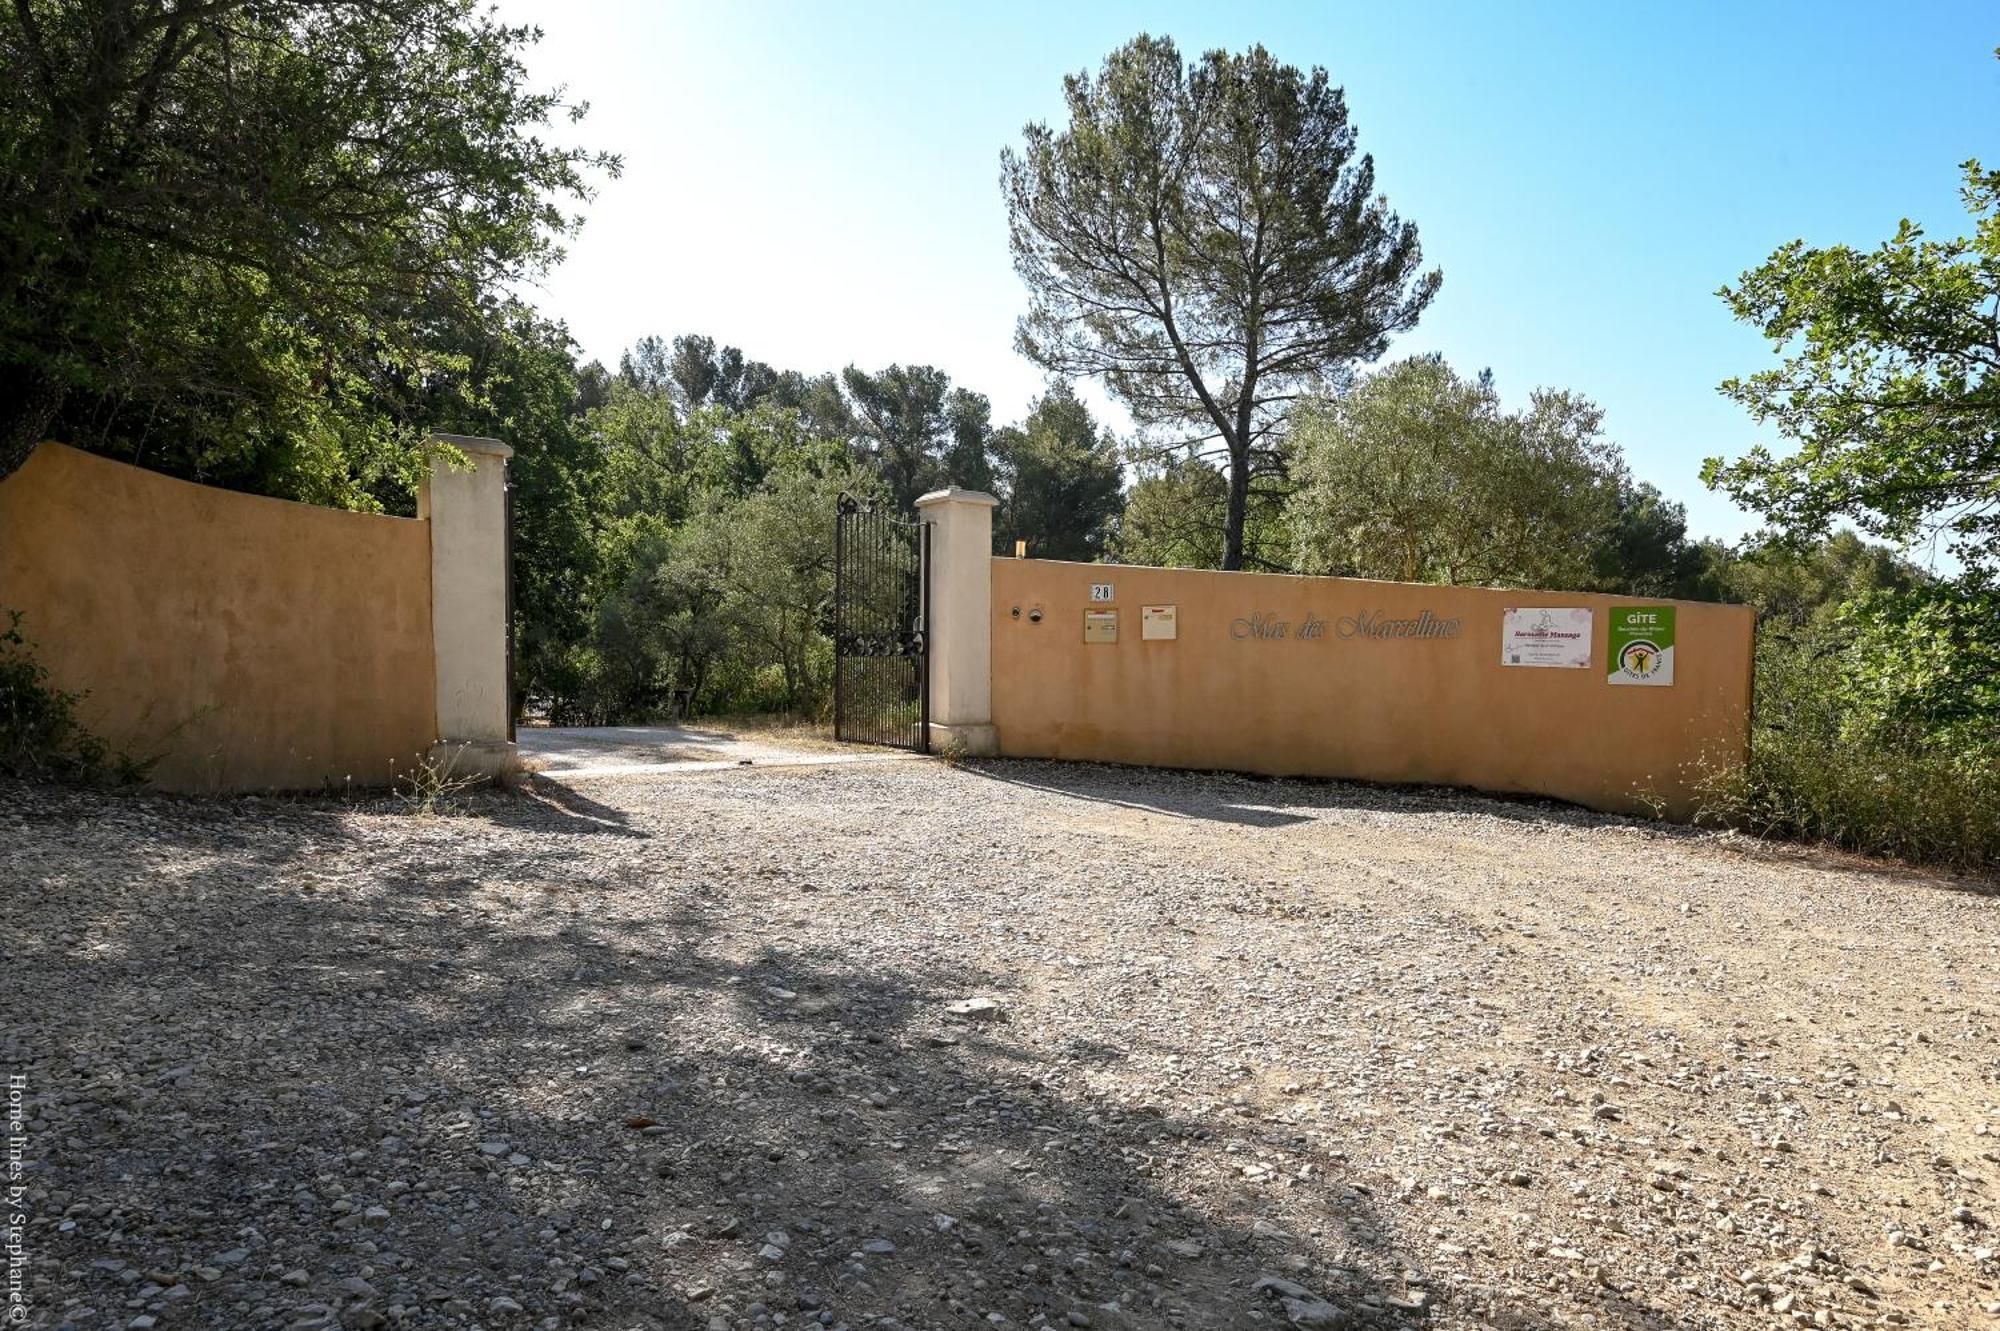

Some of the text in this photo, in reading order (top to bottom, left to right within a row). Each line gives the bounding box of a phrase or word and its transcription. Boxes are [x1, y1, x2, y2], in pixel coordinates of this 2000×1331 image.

[1094, 586, 1109, 599] 28
[1230, 608, 1288, 640] Mas
[1296, 611, 1327, 640] des
[1549, 631, 1581, 640] Massage
